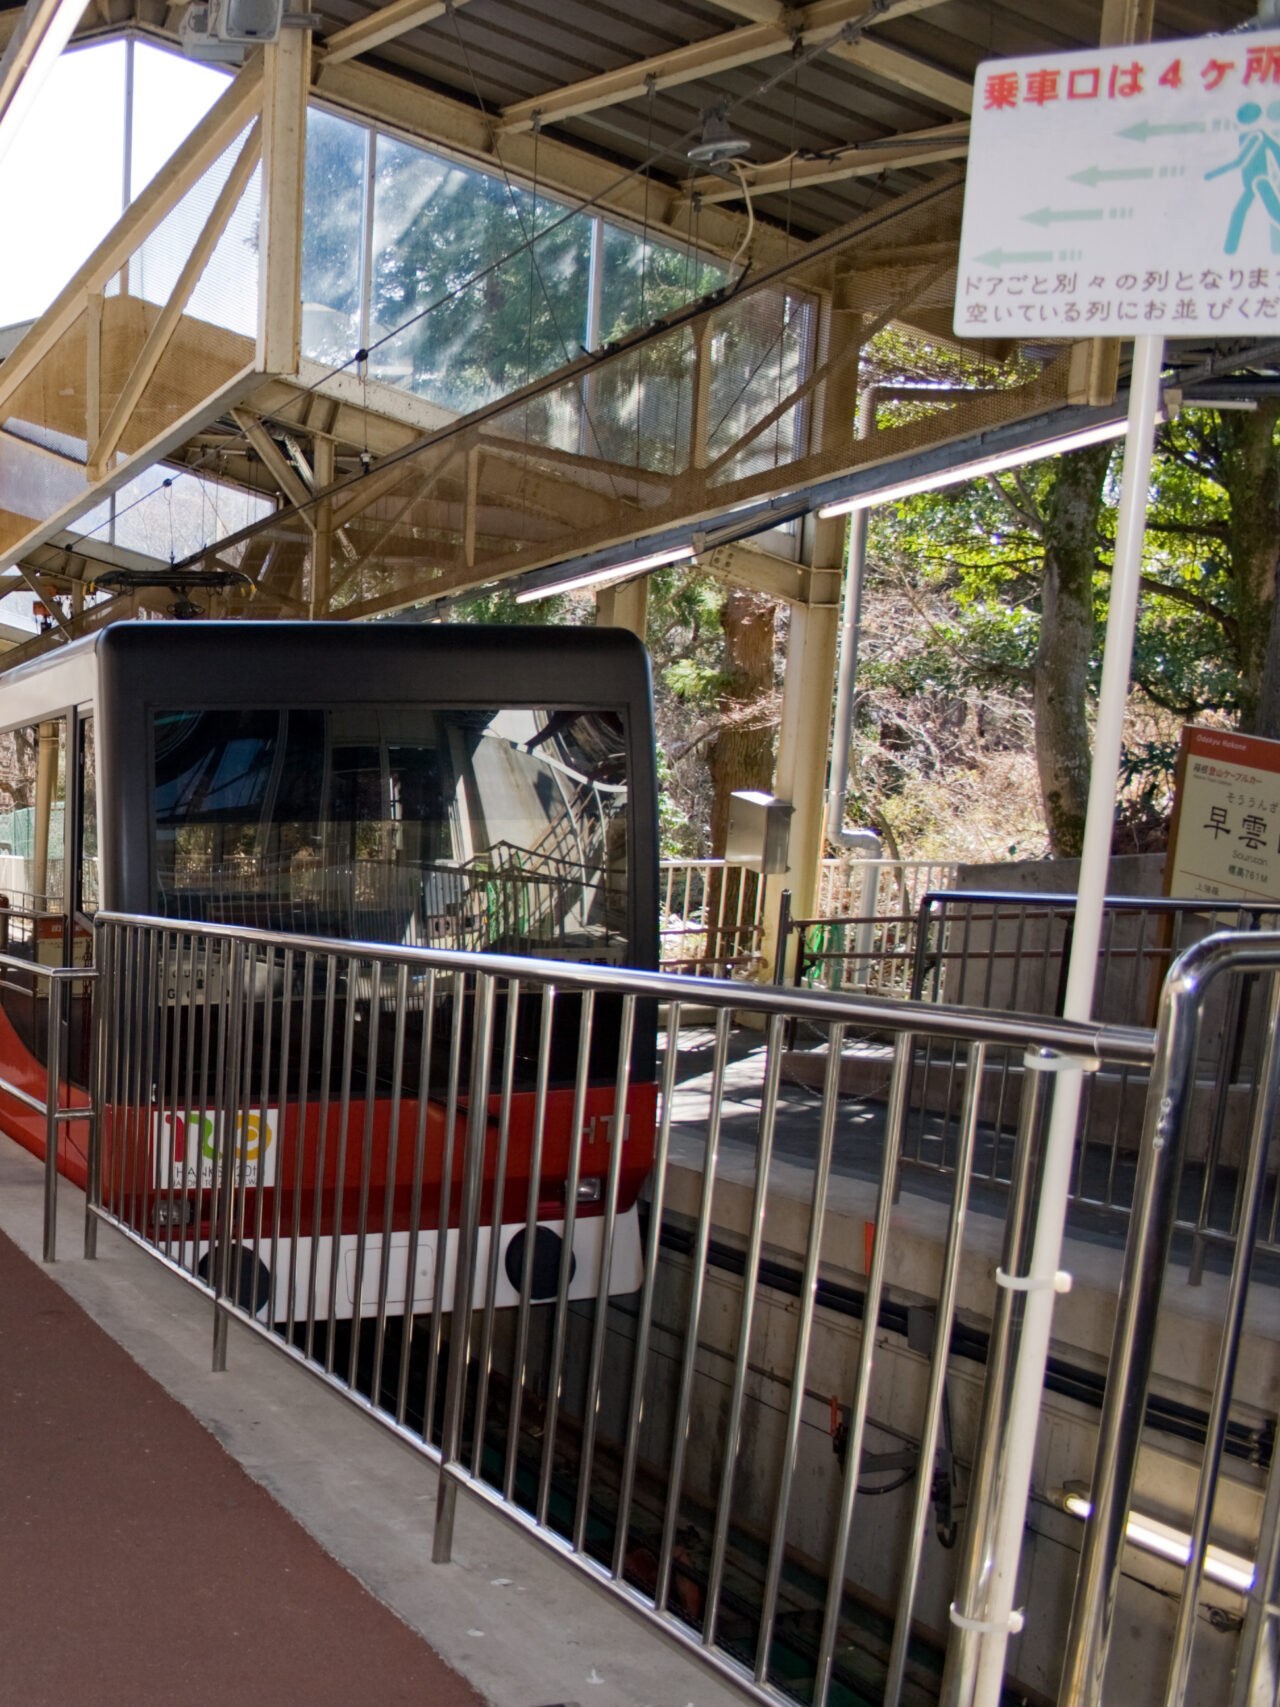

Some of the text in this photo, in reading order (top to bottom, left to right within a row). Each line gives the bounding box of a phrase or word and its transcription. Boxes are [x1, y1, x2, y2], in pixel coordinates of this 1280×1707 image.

[965, 267, 1280, 296] ドアごと別々の列となりま
[1203, 805, 1280, 854] 早雲
